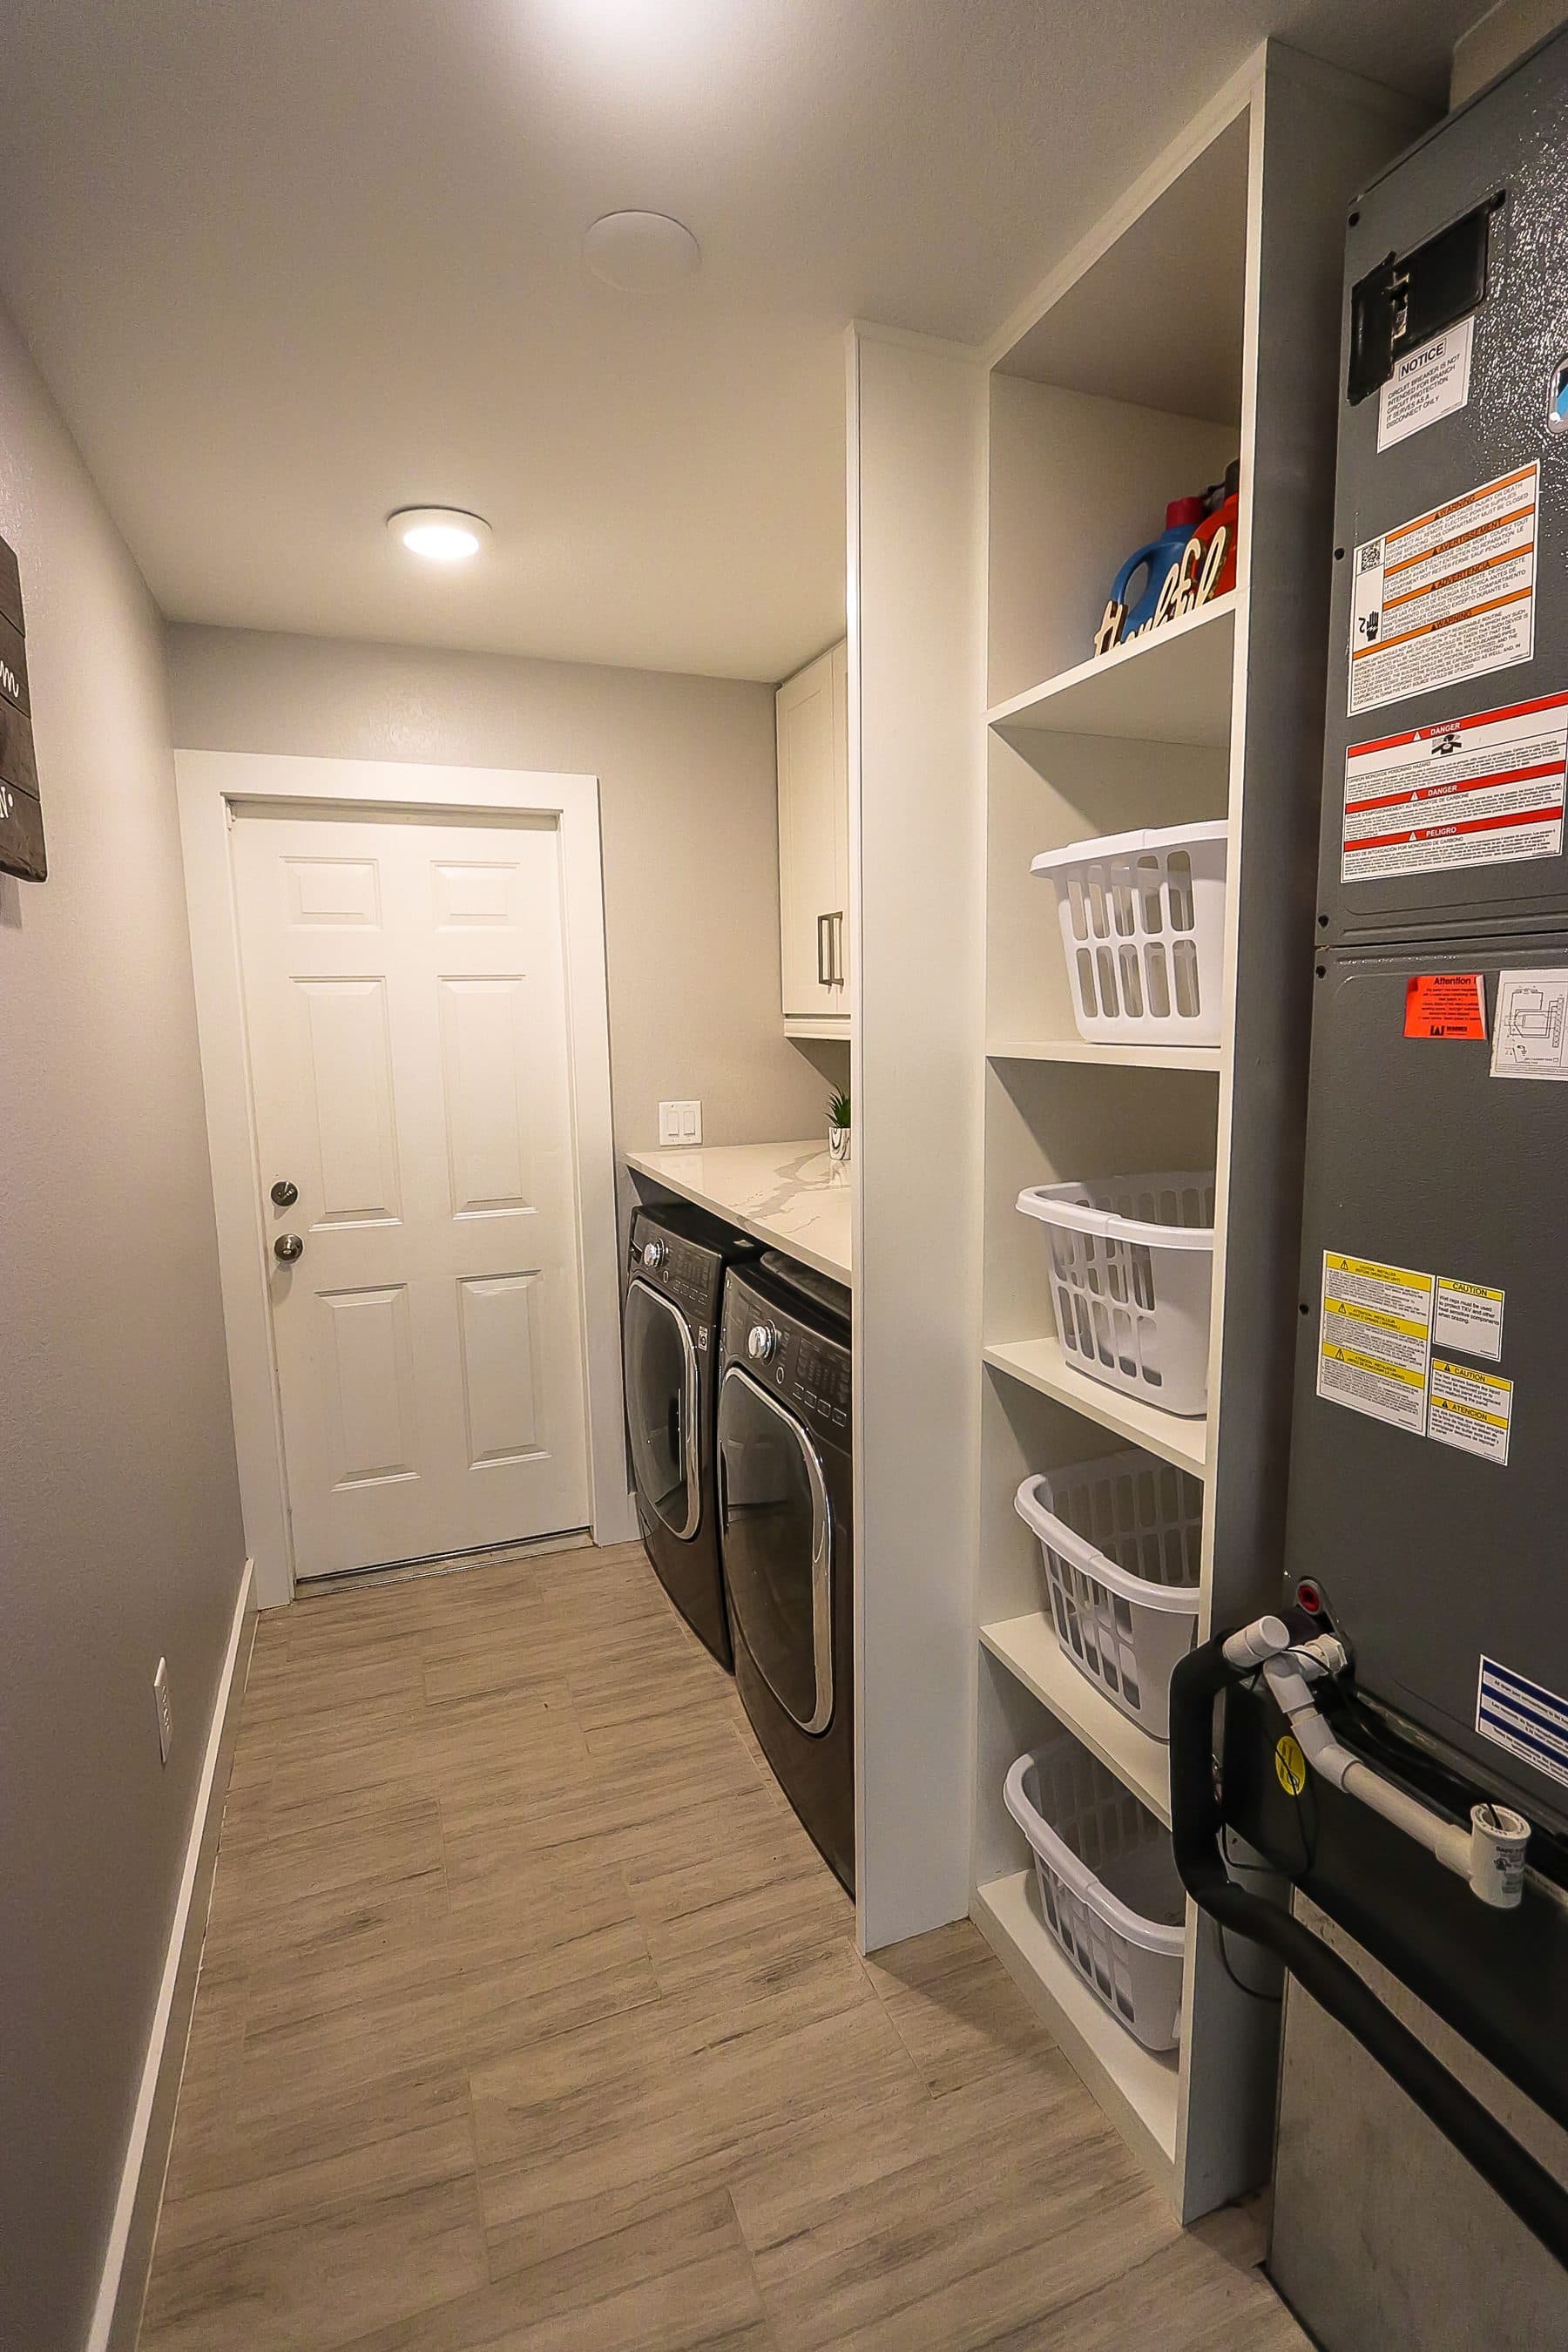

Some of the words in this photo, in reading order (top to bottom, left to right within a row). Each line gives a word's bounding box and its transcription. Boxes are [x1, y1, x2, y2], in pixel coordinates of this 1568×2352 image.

[1401, 341, 1443, 376] NOTICE
[1387, 382, 1409, 399] CIRCUIT
[1410, 365, 1439, 386] BREAKER
[1447, 353, 1460, 366] NOT
[1387, 386, 1415, 407] INTENDED
[1416, 378, 1429, 390] FOR
[1429, 363, 1455, 382] BRANCH
[1387, 397, 1409, 415] CIRCUIT
[1409, 375, 1448, 402] PROTECTION
[1386, 404, 1422, 429] DISCONNECT
[1423, 395, 1439, 409] ONLY
[1392, 401, 1415, 418] SERVES
[1423, 524, 1443, 538] REMOTE
[1444, 513, 1468, 529] ELECTRIC
[1469, 504, 1489, 517] POWER
[1490, 491, 1516, 507] SUPPLIES
[1439, 493, 1475, 517] WARNING
[1442, 514, 1479, 536] COMPARTMENT
[1481, 506, 1496, 517] MUST
[1505, 491, 1529, 507] CLOSED
[1438, 518, 1501, 552] AVERTISSEMENT
[1490, 524, 1511, 537] COUPEZ
[1513, 517, 1528, 528] TOUT
[1431, 562, 1450, 575] RESTER
[1470, 548, 1484, 558] SAUF
[1484, 537, 1510, 552] PENDANT
[1443, 548, 1470, 564] ENTRETIEN
[1488, 556, 1524, 575] DESCONECTE
[1436, 560, 1490, 587] ADVERTENCIA
[1490, 570, 1507, 581] ANTES
[1451, 594, 1475, 607] EXCEPTO
[1476, 584, 1501, 598] DURANTE
[1436, 608, 1472, 628] WARNING
[1430, 721, 1460, 735] DANGER
[1427, 784, 1457, 796] DANGER
[1426, 826, 1456, 837] PELIGRO
[1452, 1282, 1487, 1296] CAUTION
[1470, 1314, 1498, 1325] components
[1454, 1368, 1485, 1382] CAUTION
[1451, 1403, 1487, 1420] ATENCION
